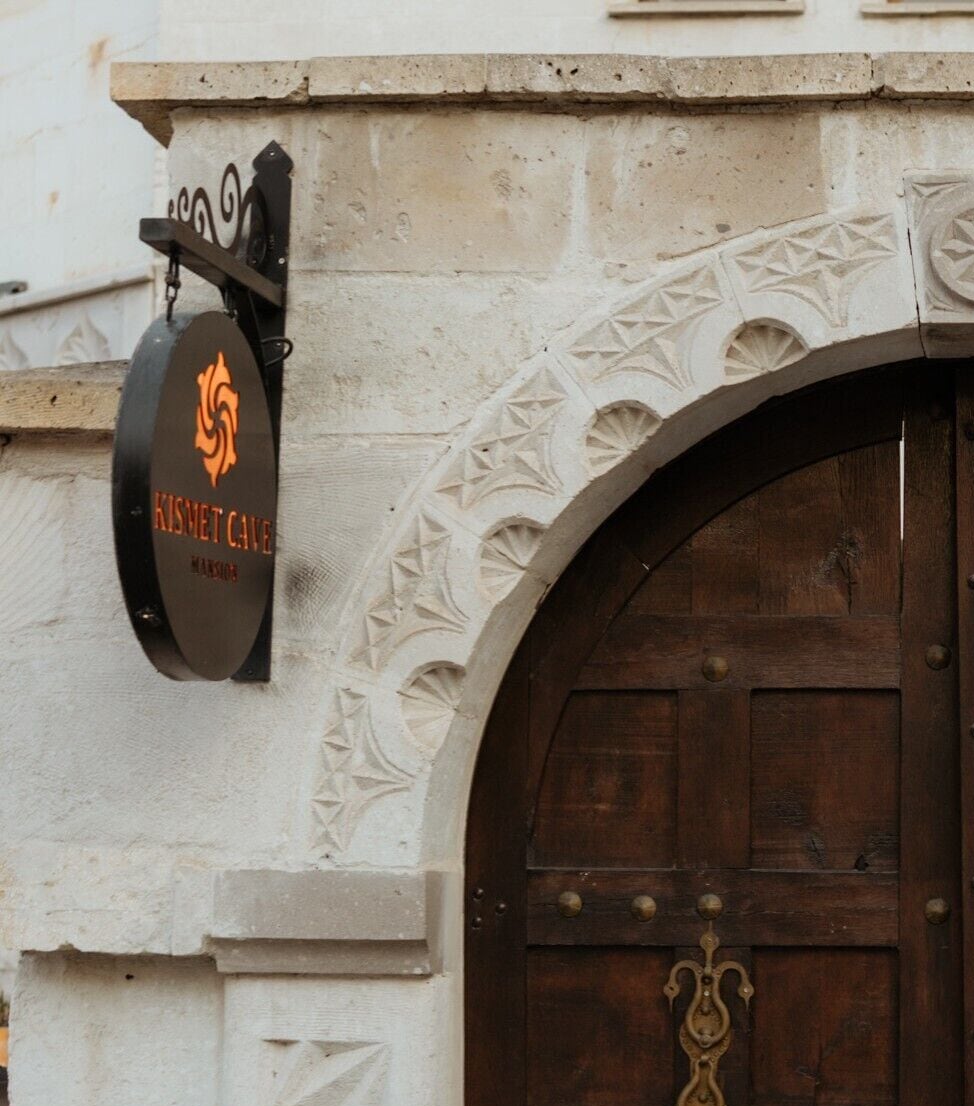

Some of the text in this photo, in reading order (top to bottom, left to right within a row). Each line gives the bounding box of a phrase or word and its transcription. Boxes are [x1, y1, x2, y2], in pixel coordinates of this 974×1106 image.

[155, 491, 272, 554] KISMET CAVE
[191, 556, 238, 582] MANSION
